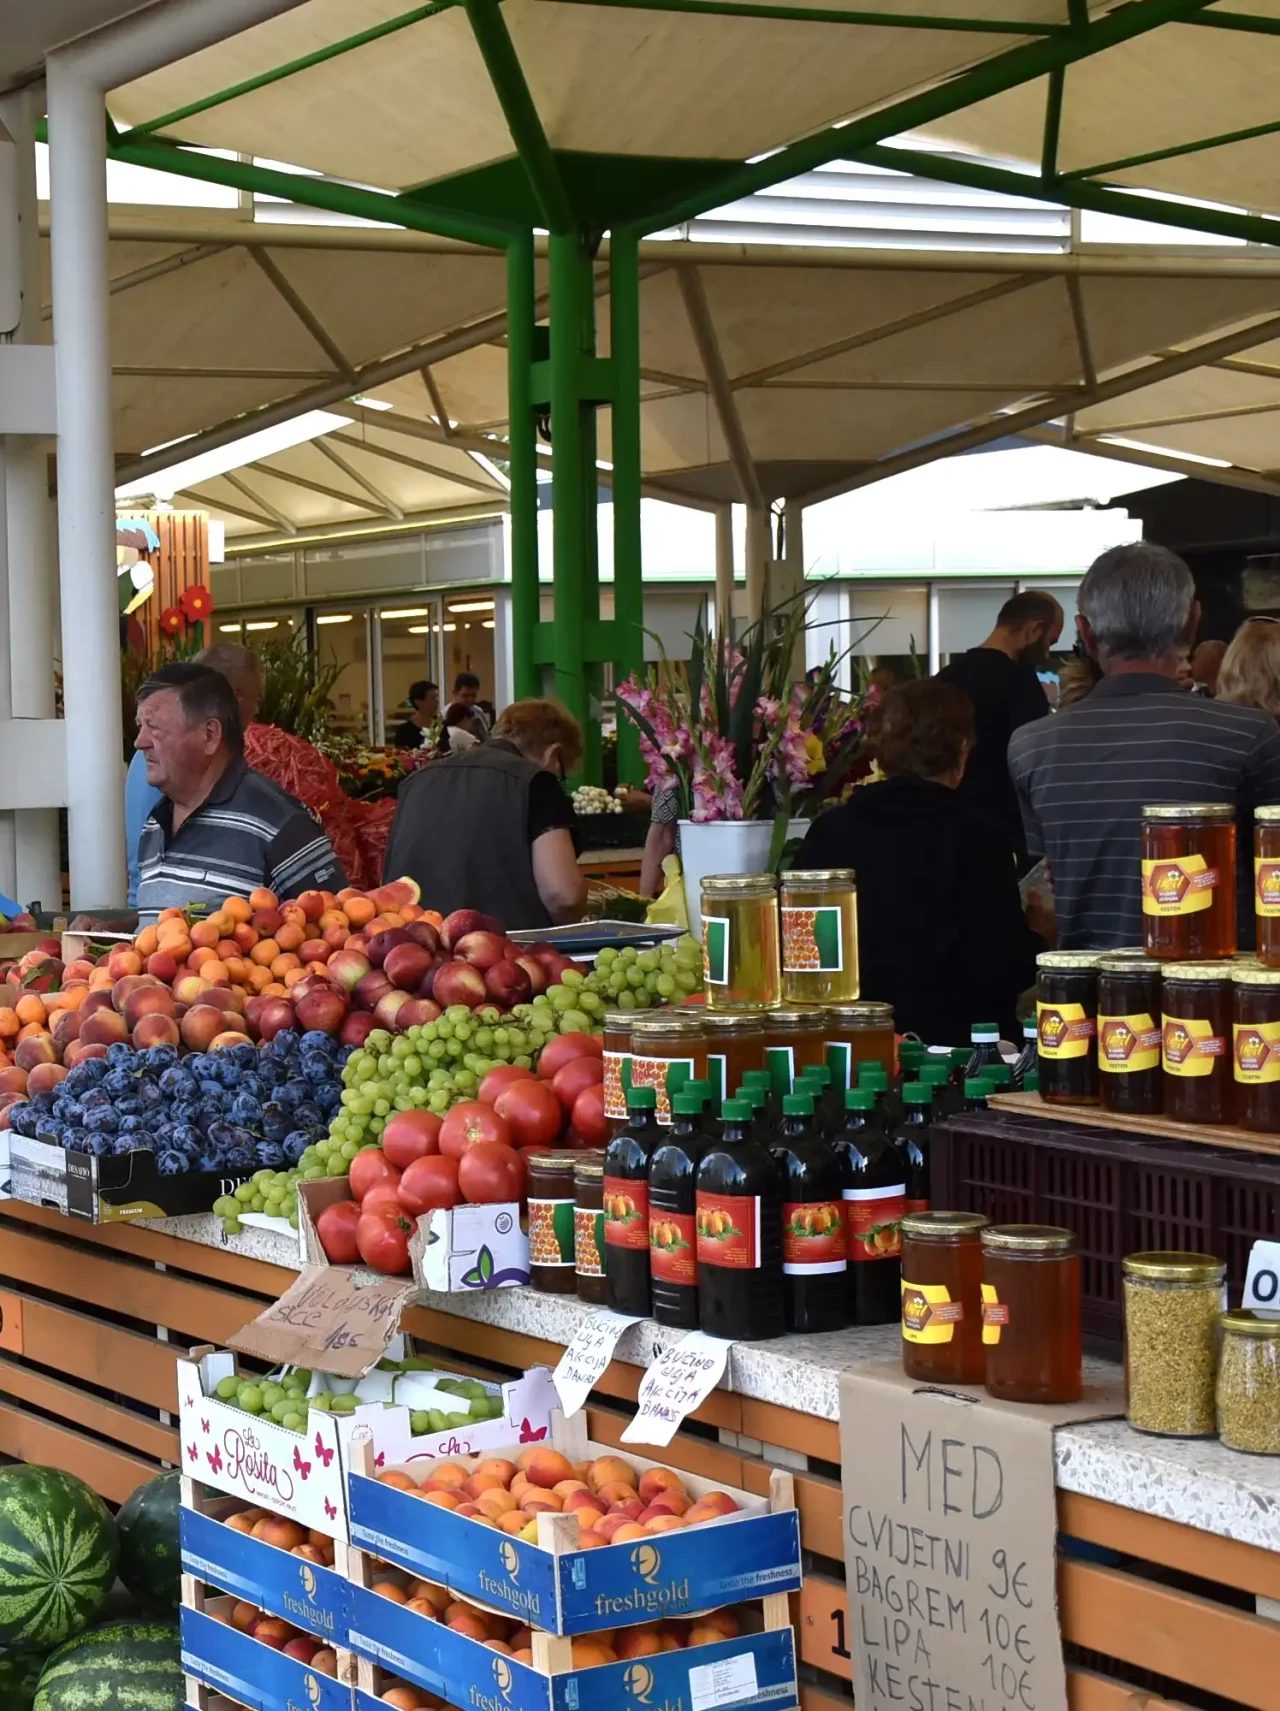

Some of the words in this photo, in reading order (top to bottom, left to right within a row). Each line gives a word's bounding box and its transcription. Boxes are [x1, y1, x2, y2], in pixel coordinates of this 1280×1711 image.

[223, 1428, 294, 1501] Rosita
[901, 1422, 1003, 1519] MED
[848, 1505, 970, 1581] CVIJETNI
[478, 1570, 541, 1614] freshgold
[595, 1578, 689, 1615] freshgold
[755, 1568, 793, 1582] freshness
[283, 1591, 334, 1631] freshgold
[855, 1555, 967, 1633] BAGREM
[979, 1608, 1036, 1664] 10€
[861, 1604, 932, 1669] LIPA
[469, 1684, 524, 1711] fresh
